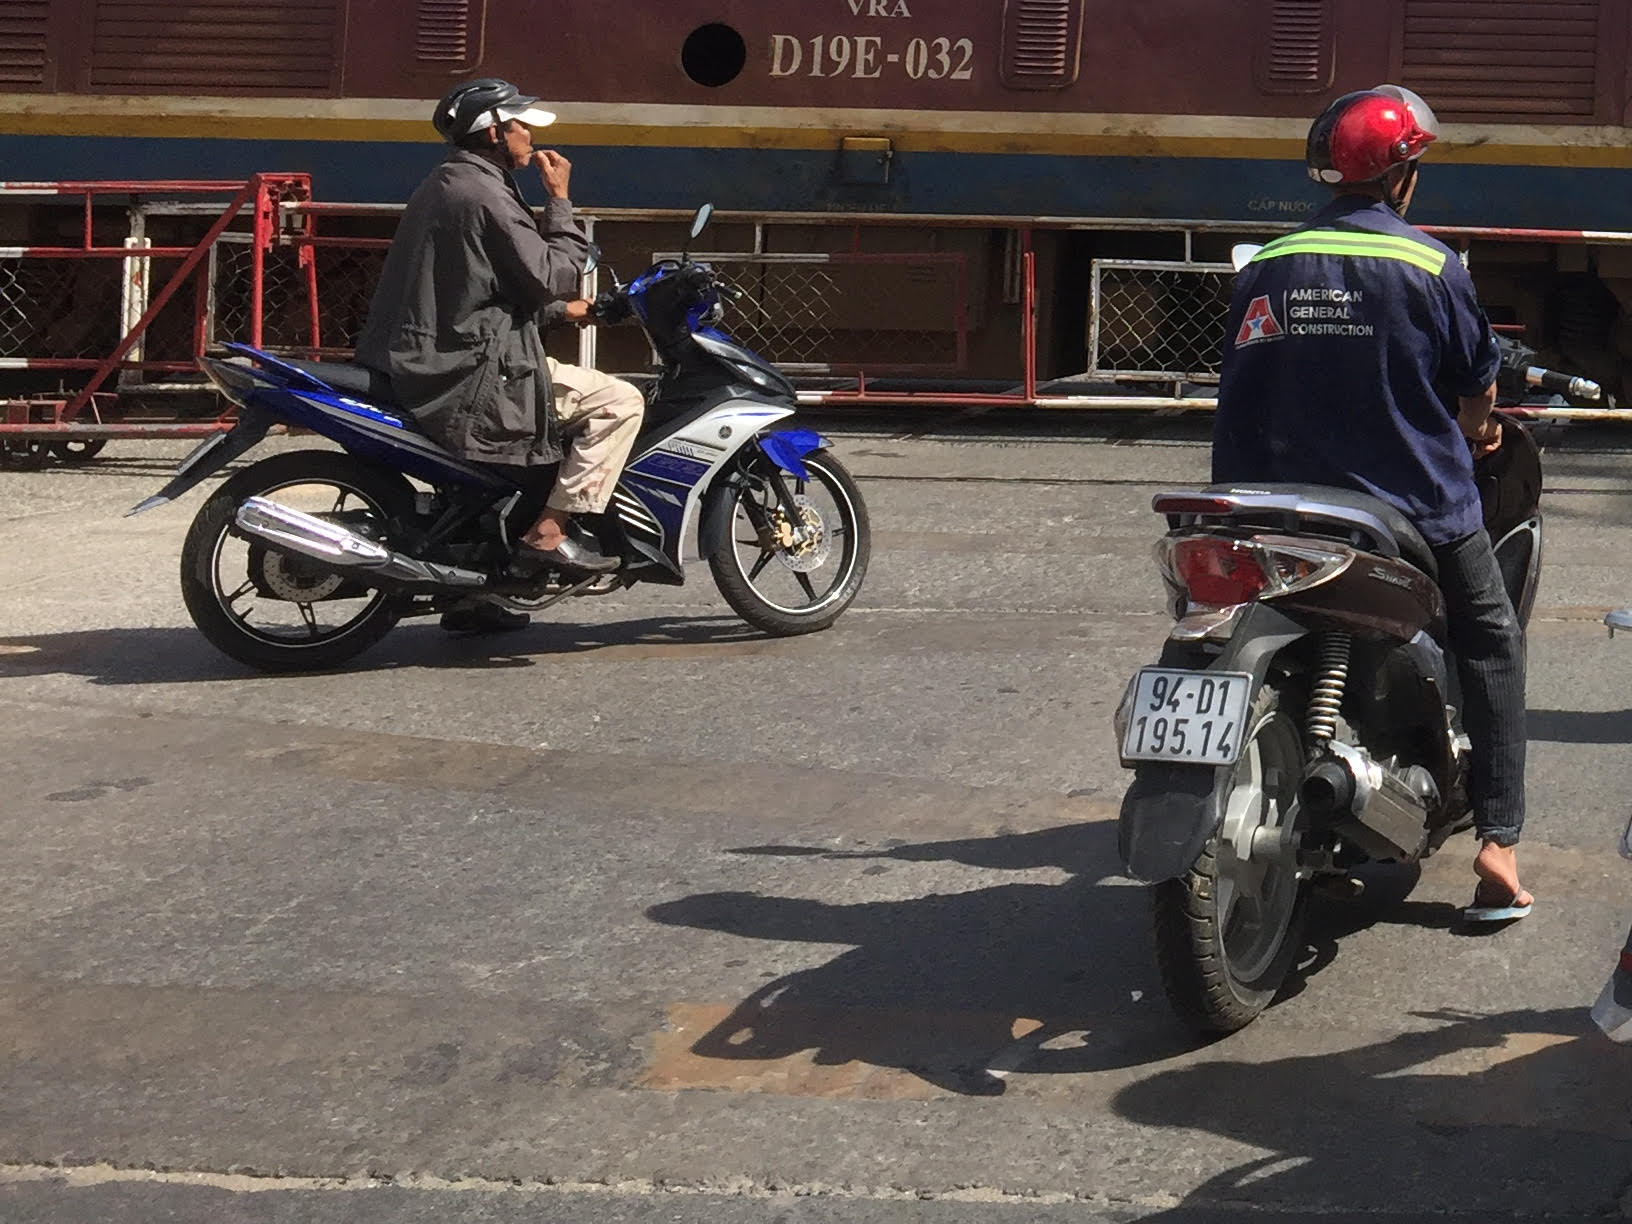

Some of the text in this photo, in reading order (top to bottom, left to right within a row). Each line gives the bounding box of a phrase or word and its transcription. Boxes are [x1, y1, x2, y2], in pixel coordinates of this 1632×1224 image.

[768, 33, 975, 81] D19E-032
[1289, 288, 1364, 303] AMERICAN
[1289, 306, 1351, 320] GENERAL
[1290, 323, 1375, 337] CONSTRUCTION
[1150, 675, 1231, 716] 94-D1
[1136, 715, 1235, 759] 195.14
